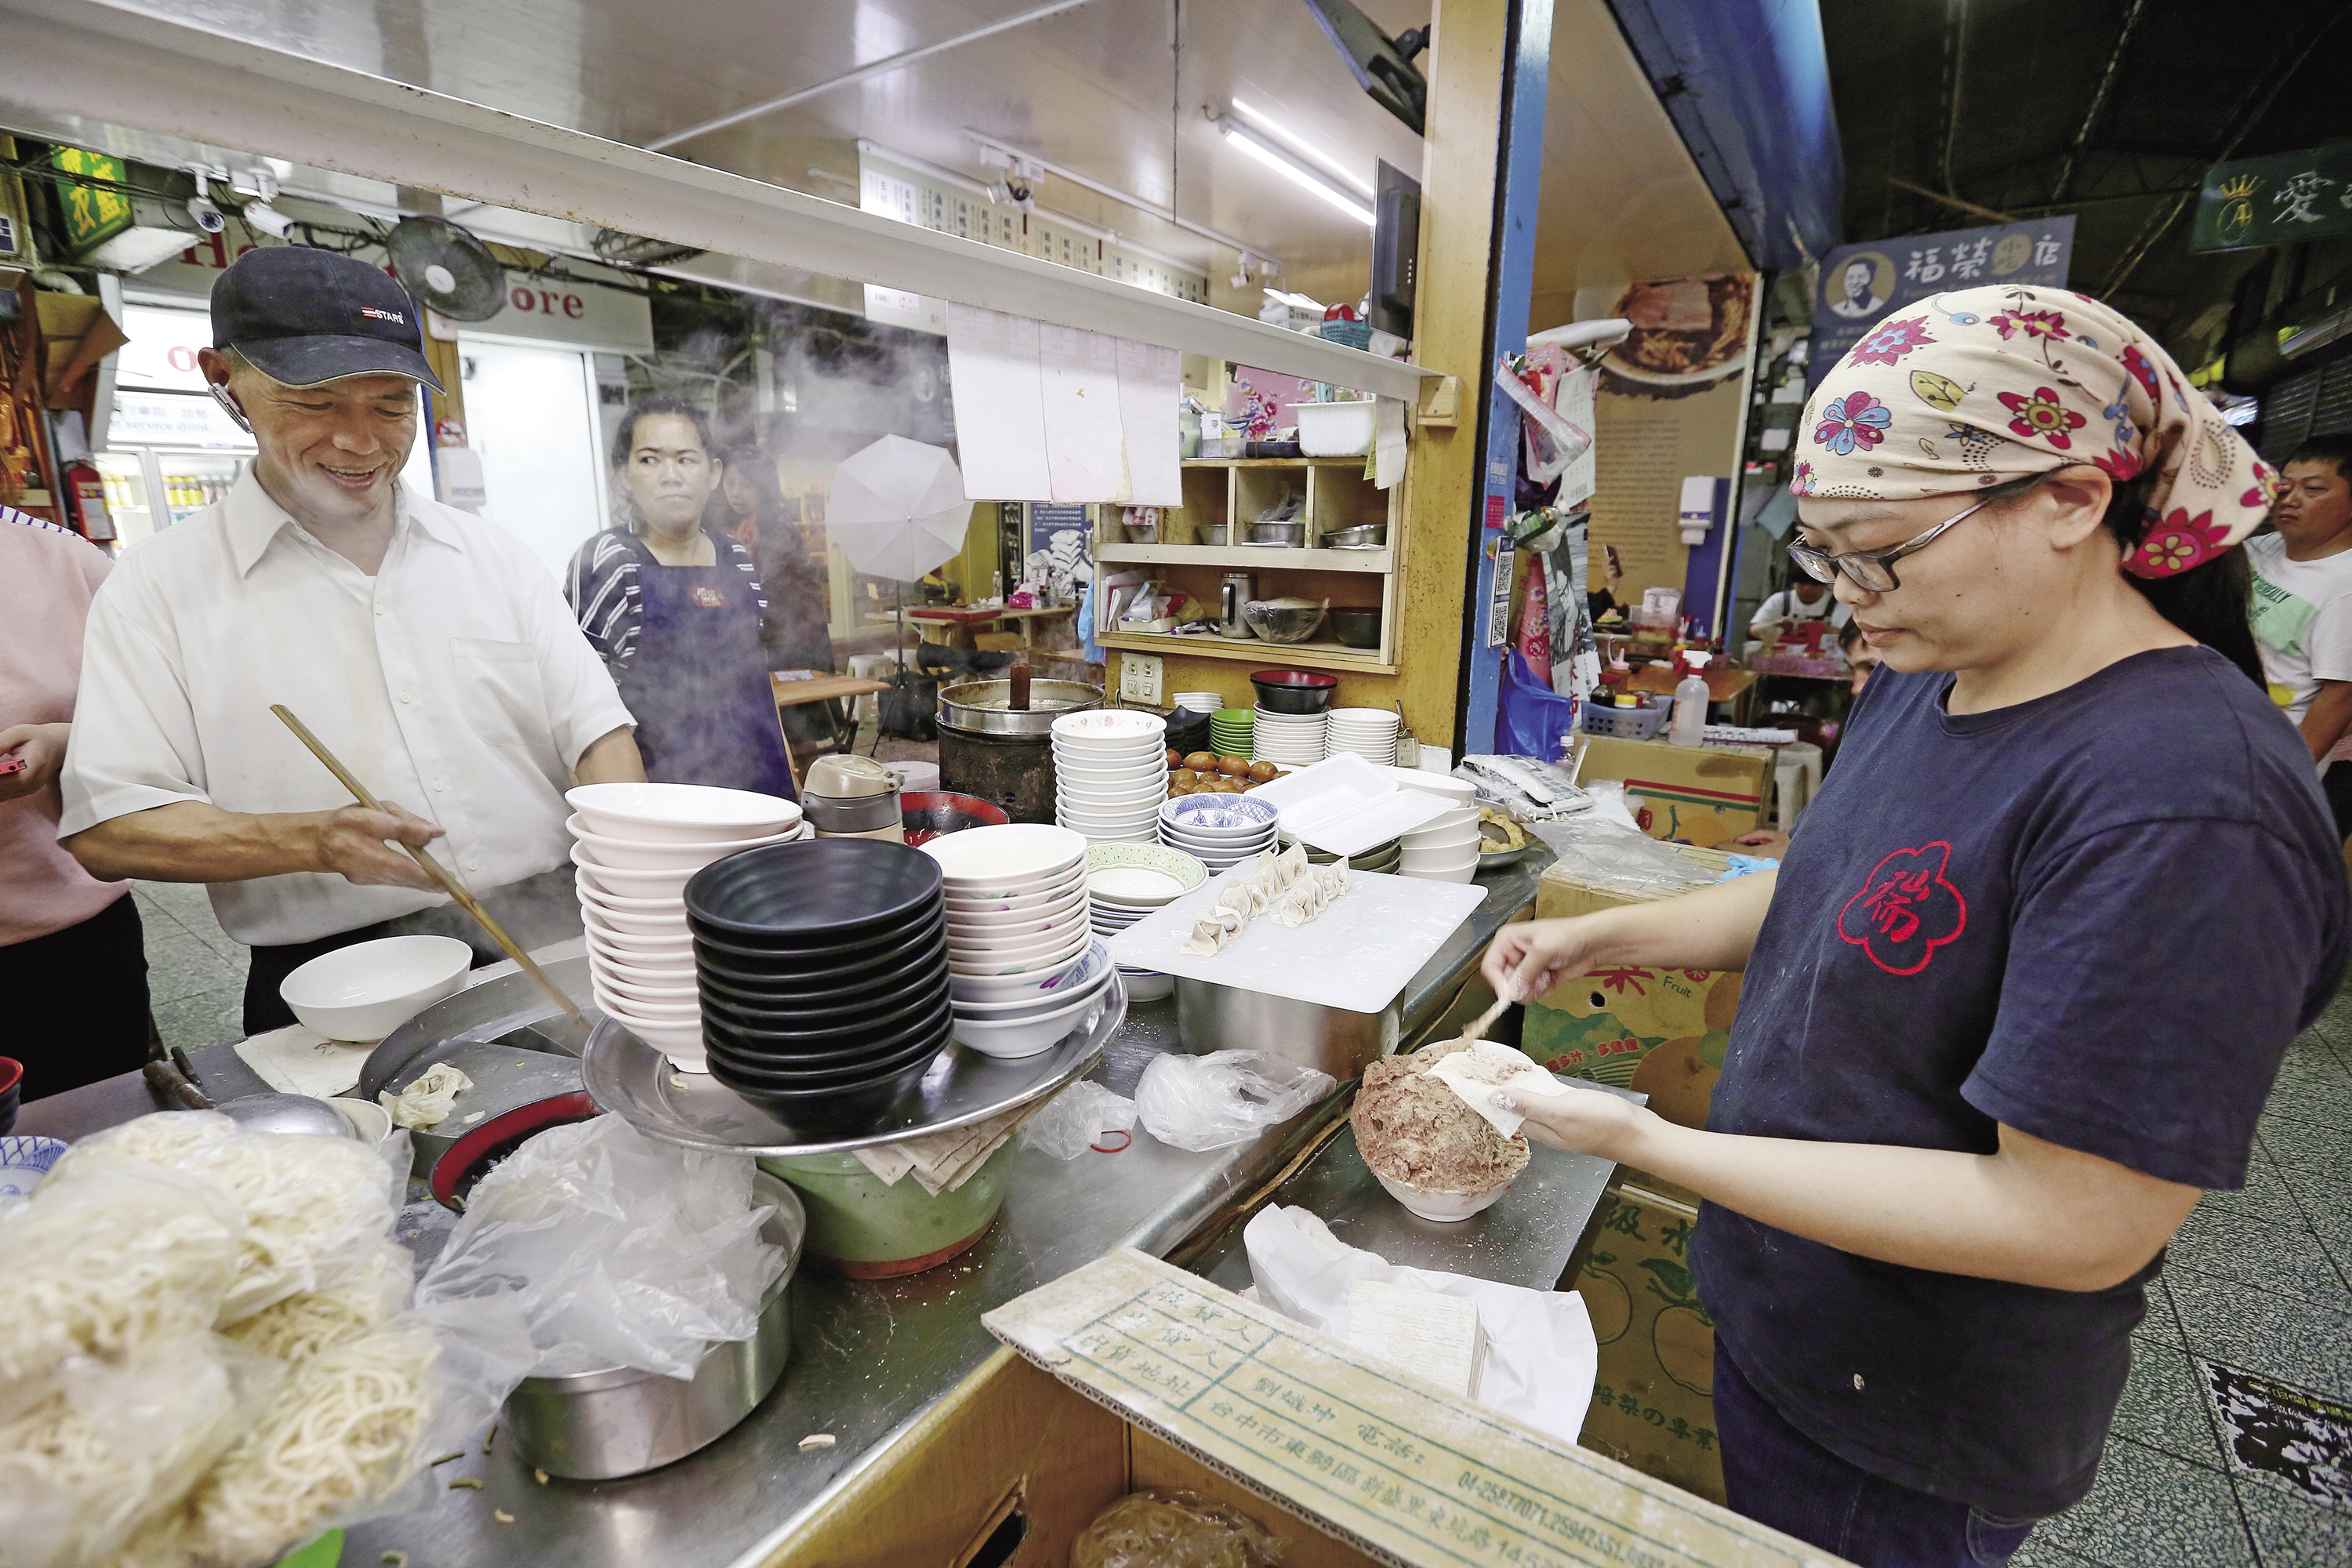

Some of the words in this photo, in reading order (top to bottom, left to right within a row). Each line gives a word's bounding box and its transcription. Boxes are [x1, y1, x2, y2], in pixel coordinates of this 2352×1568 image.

[504, 286, 585, 320] ore
[375, 309, 404, 325] STARS
[1662, 975, 1693, 999] Fruit
